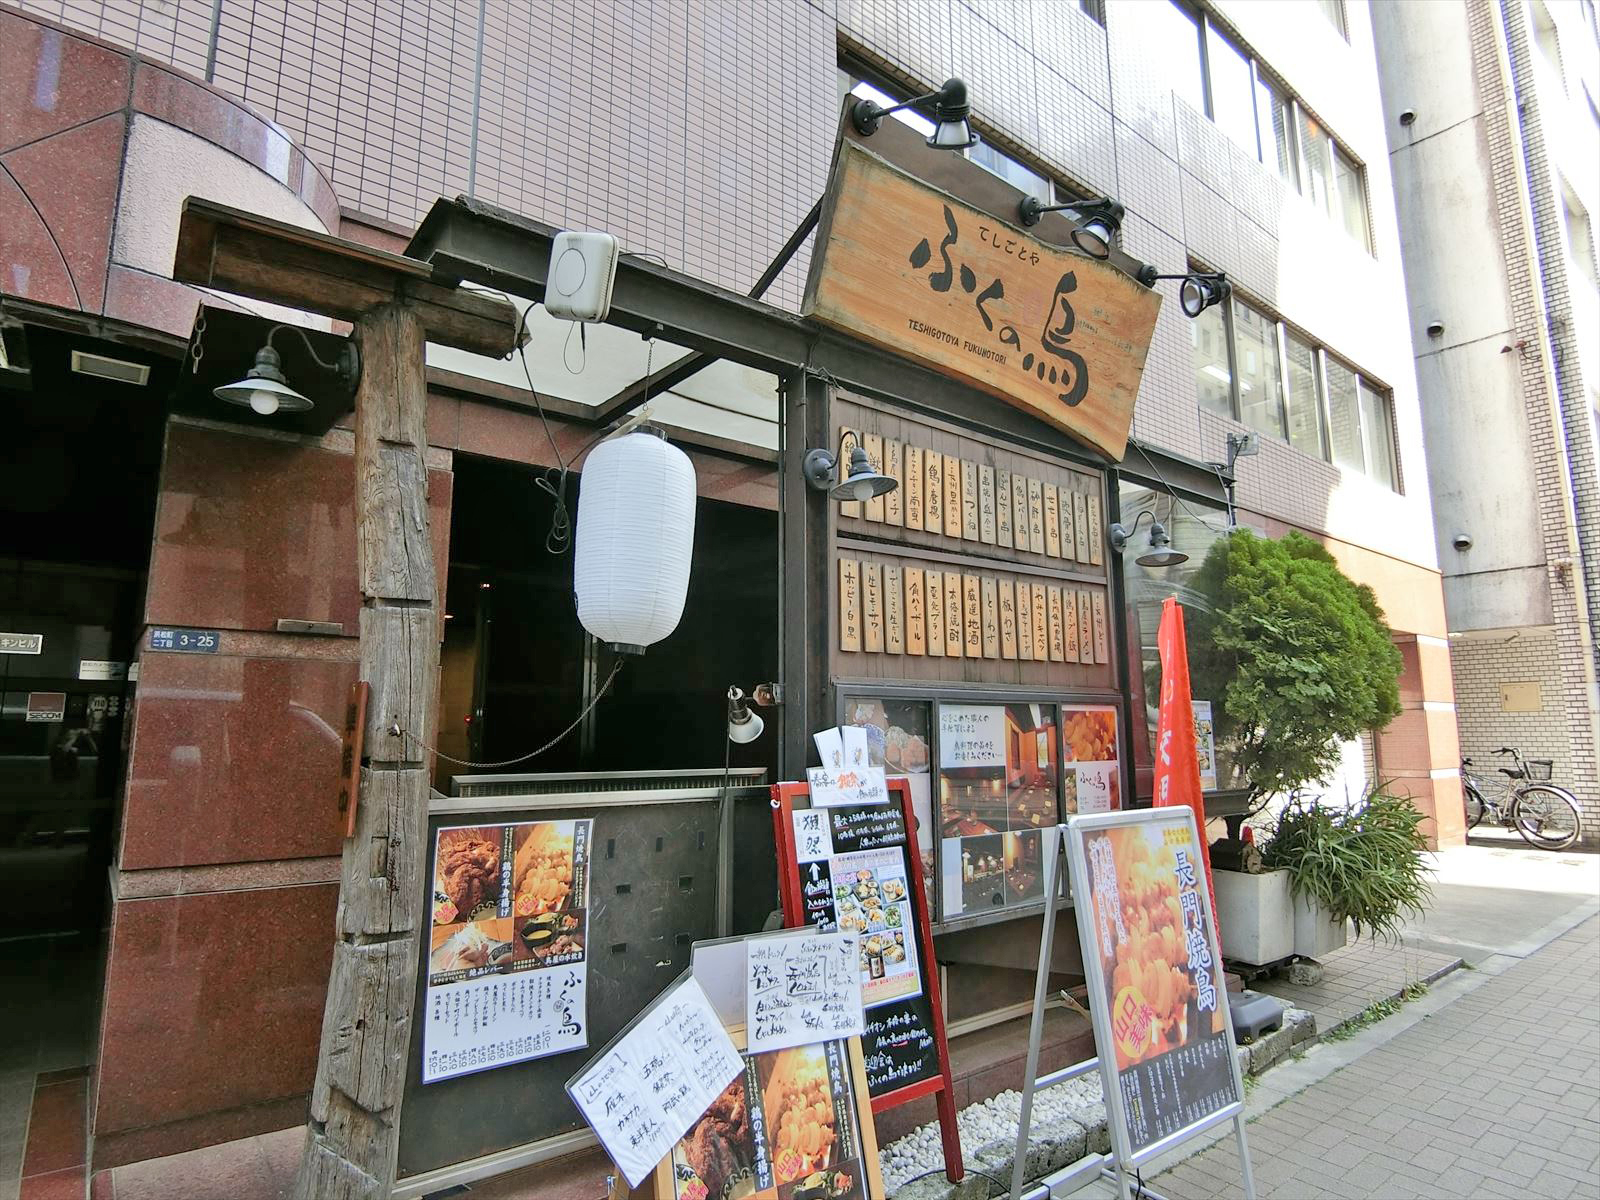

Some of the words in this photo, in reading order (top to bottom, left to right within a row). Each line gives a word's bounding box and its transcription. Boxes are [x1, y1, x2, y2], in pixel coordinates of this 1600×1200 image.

[979, 226, 1040, 266] てしごとや
[908, 319, 960, 348] TESHIGOTOYA
[153, 639, 173, 648] 二丁目
[179, 635, 214, 647] 3-25
[1175, 851, 1216, 1011] 長門焼鳥
[558, 971, 582, 1035] ふくの鳥
[1115, 992, 1137, 1042] 山口
